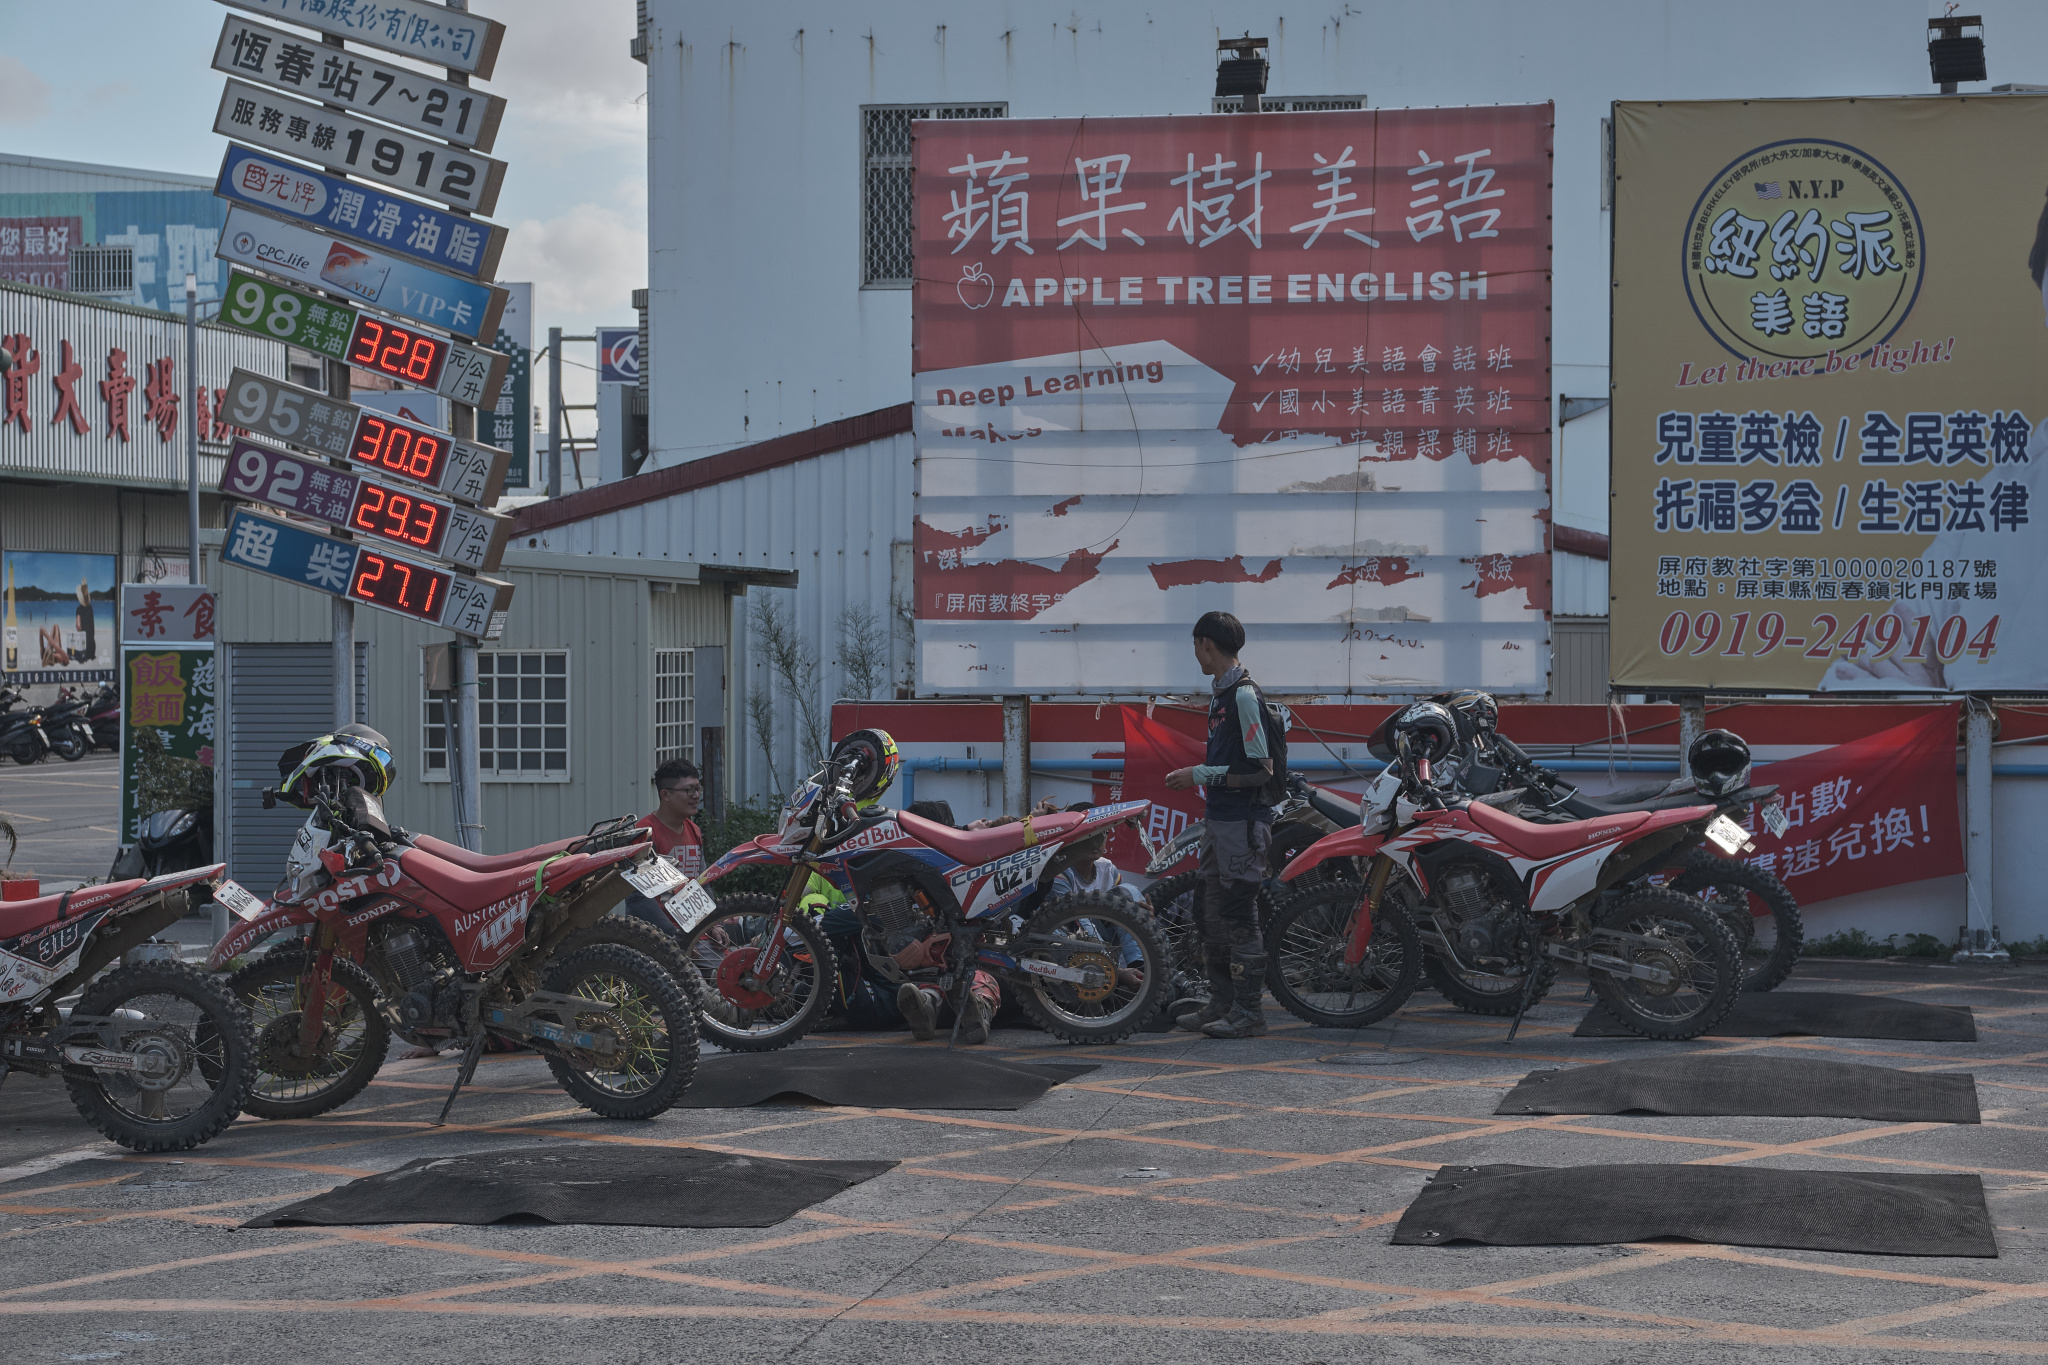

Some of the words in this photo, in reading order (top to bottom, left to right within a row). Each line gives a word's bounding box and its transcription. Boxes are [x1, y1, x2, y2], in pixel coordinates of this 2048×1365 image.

[942, 145, 1505, 255] 蘋果樹美語
[1788, 179, 1845, 200] N.Y.P
[242, 163, 317, 213] 國光牌
[328, 187, 481, 267] 潤滑油脂
[1704, 207, 1903, 284] 紐約派
[354, 281, 376, 297] VIP
[1001, 276, 1144, 307] APPLE
[1156, 275, 1272, 306] TREE
[1287, 271, 1487, 303] ENGLISH
[230, 281, 302, 337] 98
[307, 303, 350, 332] 無鉛
[1750, 287, 1850, 340] 美語
[302, 325, 342, 355] 汽油
[1277, 344, 1513, 375] 幼兒美語會話班
[1675, 362, 1728, 388] Let
[1735, 356, 1816, 383] there
[1824, 348, 1861, 374] be
[1869, 336, 1956, 374] light!
[936, 384, 1015, 407] Deep
[1024, 360, 1164, 398] Learning
[233, 381, 304, 436] 95
[308, 402, 352, 430] 無鉛
[1278, 386, 1513, 415] 國小美語菁英班
[302, 423, 347, 453] 汽油
[1654, 411, 1823, 467] 兒童英檢
[1859, 410, 2032, 467] 全民英檢
[233, 449, 304, 507] 92
[309, 470, 352, 499] 無鉛
[303, 492, 346, 522] 汽油
[1654, 478, 1824, 534] 托福多益
[1858, 478, 2031, 534] 生活法律
[1659, 609, 2002, 663] 0919-249104
[1588, 826, 1622, 841] HONDA
[518, 870, 552, 888] HONA
[951, 845, 1041, 887] COOPER
[1000, 856, 1041, 878] TIRES
[69, 893, 112, 910] HONDA
[347, 900, 401, 927] HONDA
[218, 914, 293, 964] AUSTRALIA
[480, 897, 529, 951] 404
[39, 922, 79, 963] 318
[765, 943, 781, 973] SHOWA
[1028, 963, 1043, 973] Red
[1042, 965, 1057, 976] Bull
